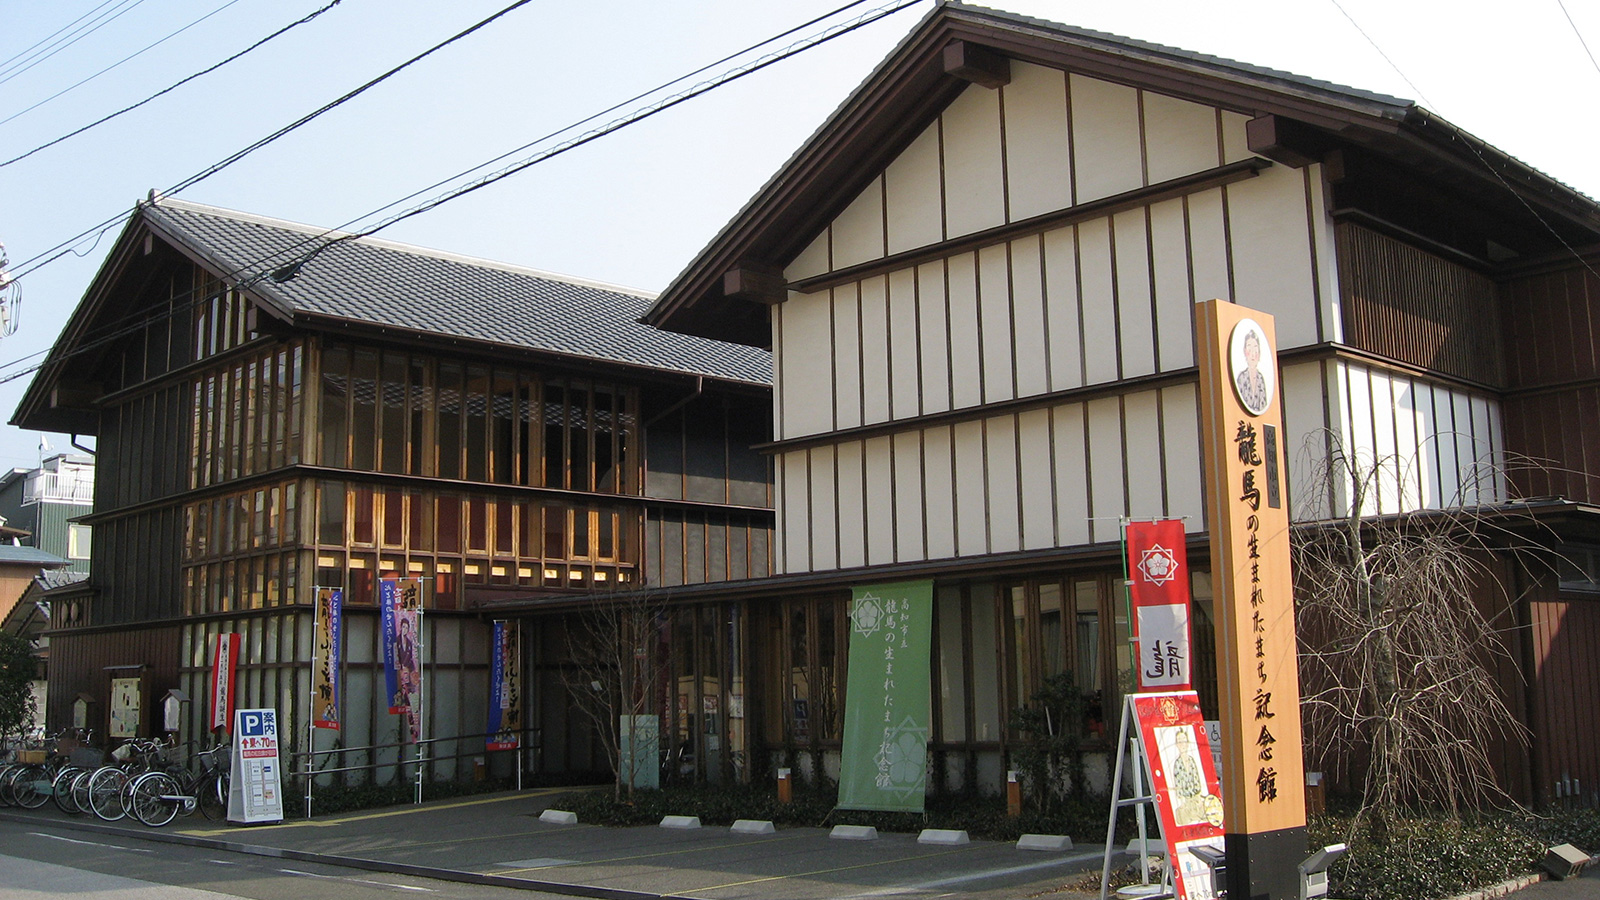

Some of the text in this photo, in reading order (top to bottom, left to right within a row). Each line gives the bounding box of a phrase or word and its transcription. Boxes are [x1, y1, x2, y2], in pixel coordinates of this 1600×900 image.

[899, 597, 910, 649] 高知市立
[1233, 420, 1278, 804] 龍馬の生まれたまち記念館
[874, 598, 899, 788] 龍馬の生まれたまち記念館
[245, 711, 275, 735] P 案内
[249, 736, 277, 748] 東へ70m
